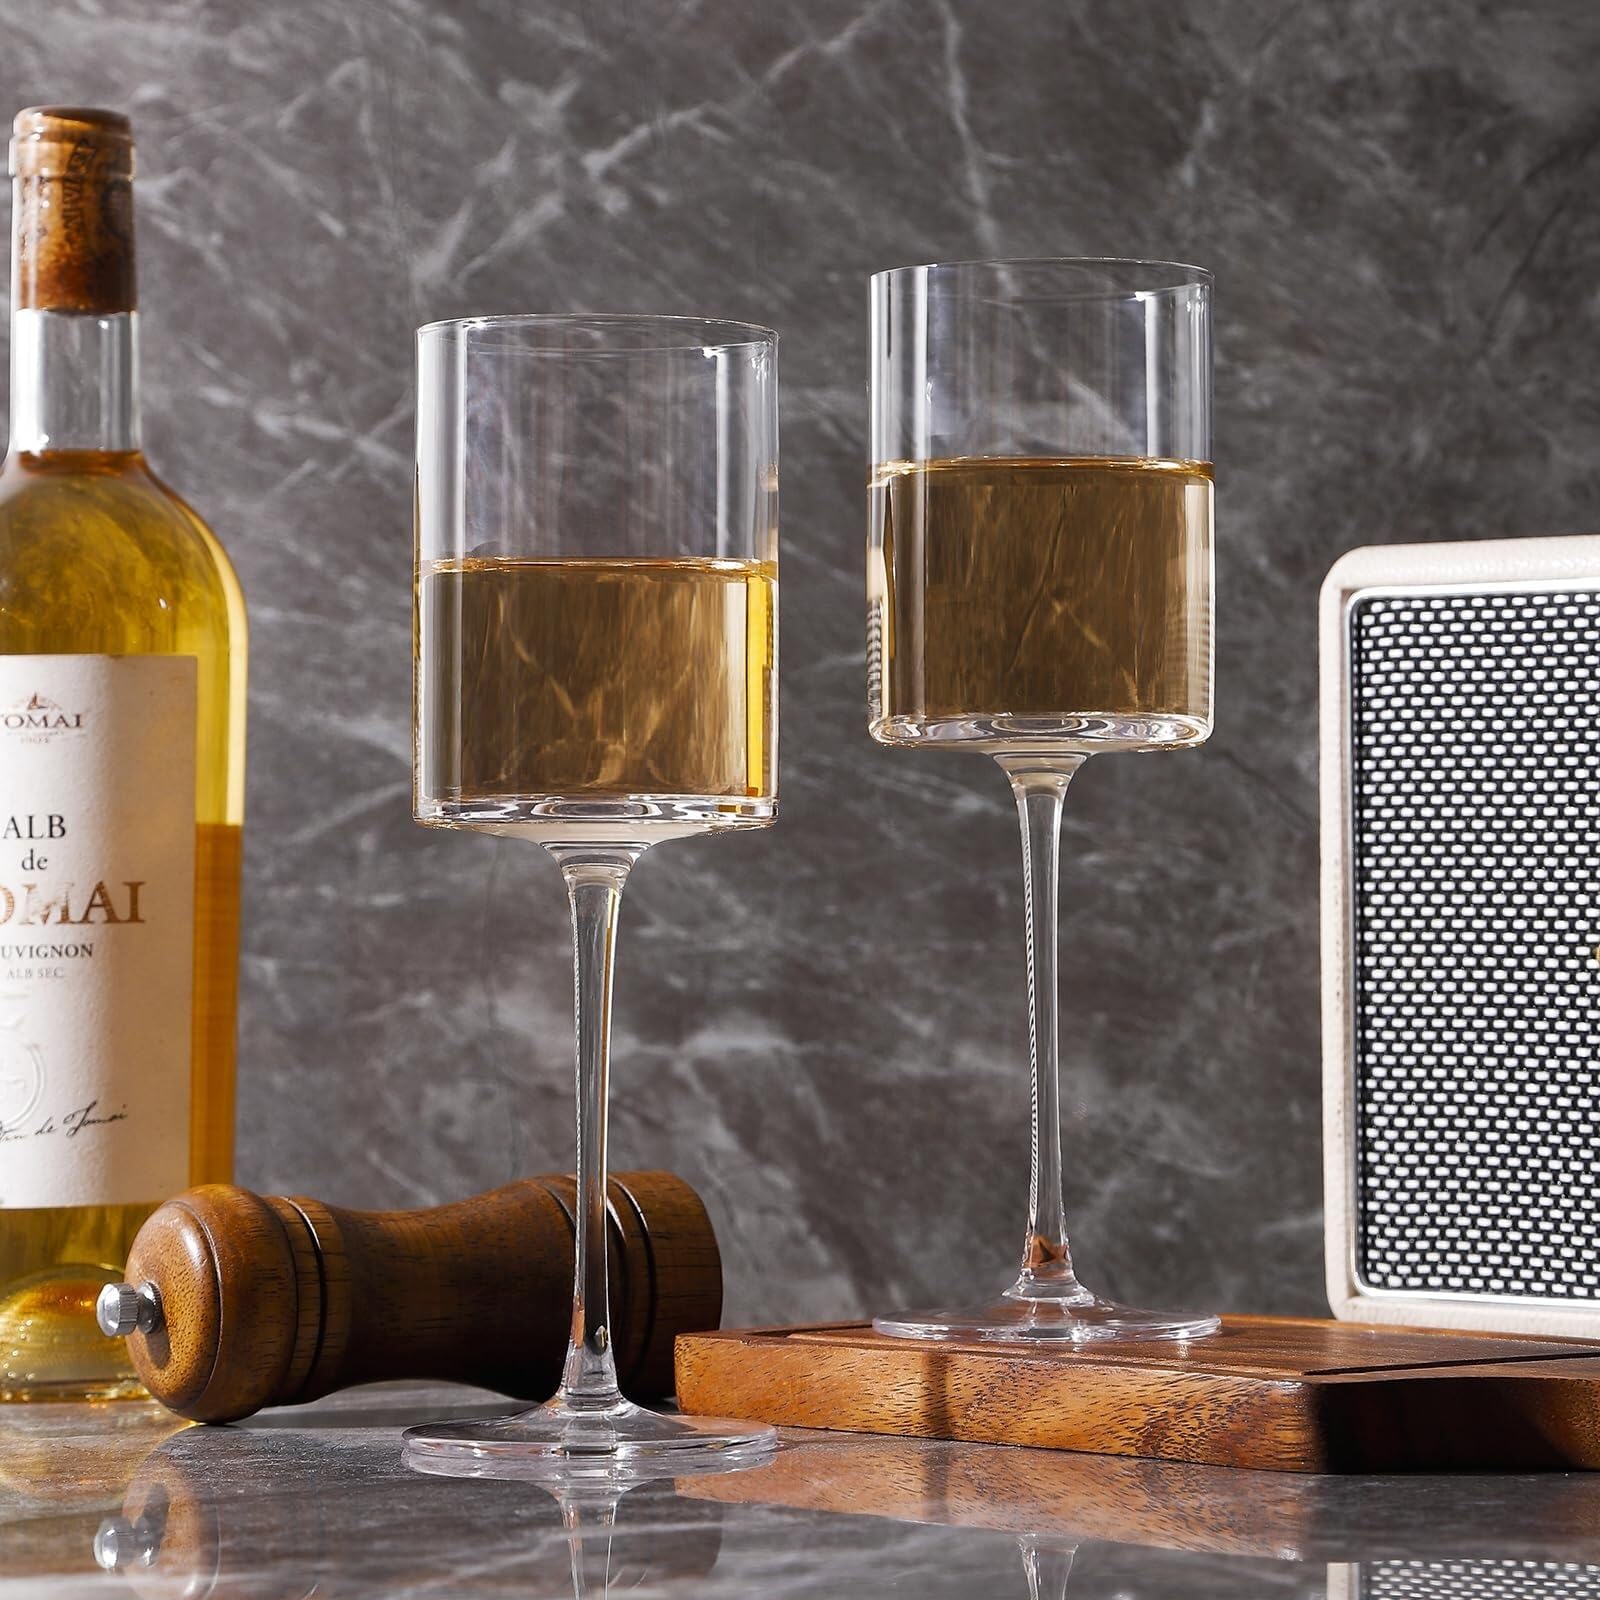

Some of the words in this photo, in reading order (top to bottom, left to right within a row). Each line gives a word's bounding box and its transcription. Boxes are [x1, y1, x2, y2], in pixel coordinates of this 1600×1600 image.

[0, 713, 83, 729] OMAI
[3, 814, 66, 839] ALB
[21, 847, 49, 871] de
[7, 966, 33, 980] ALB
[37, 966, 65, 980] SEC
